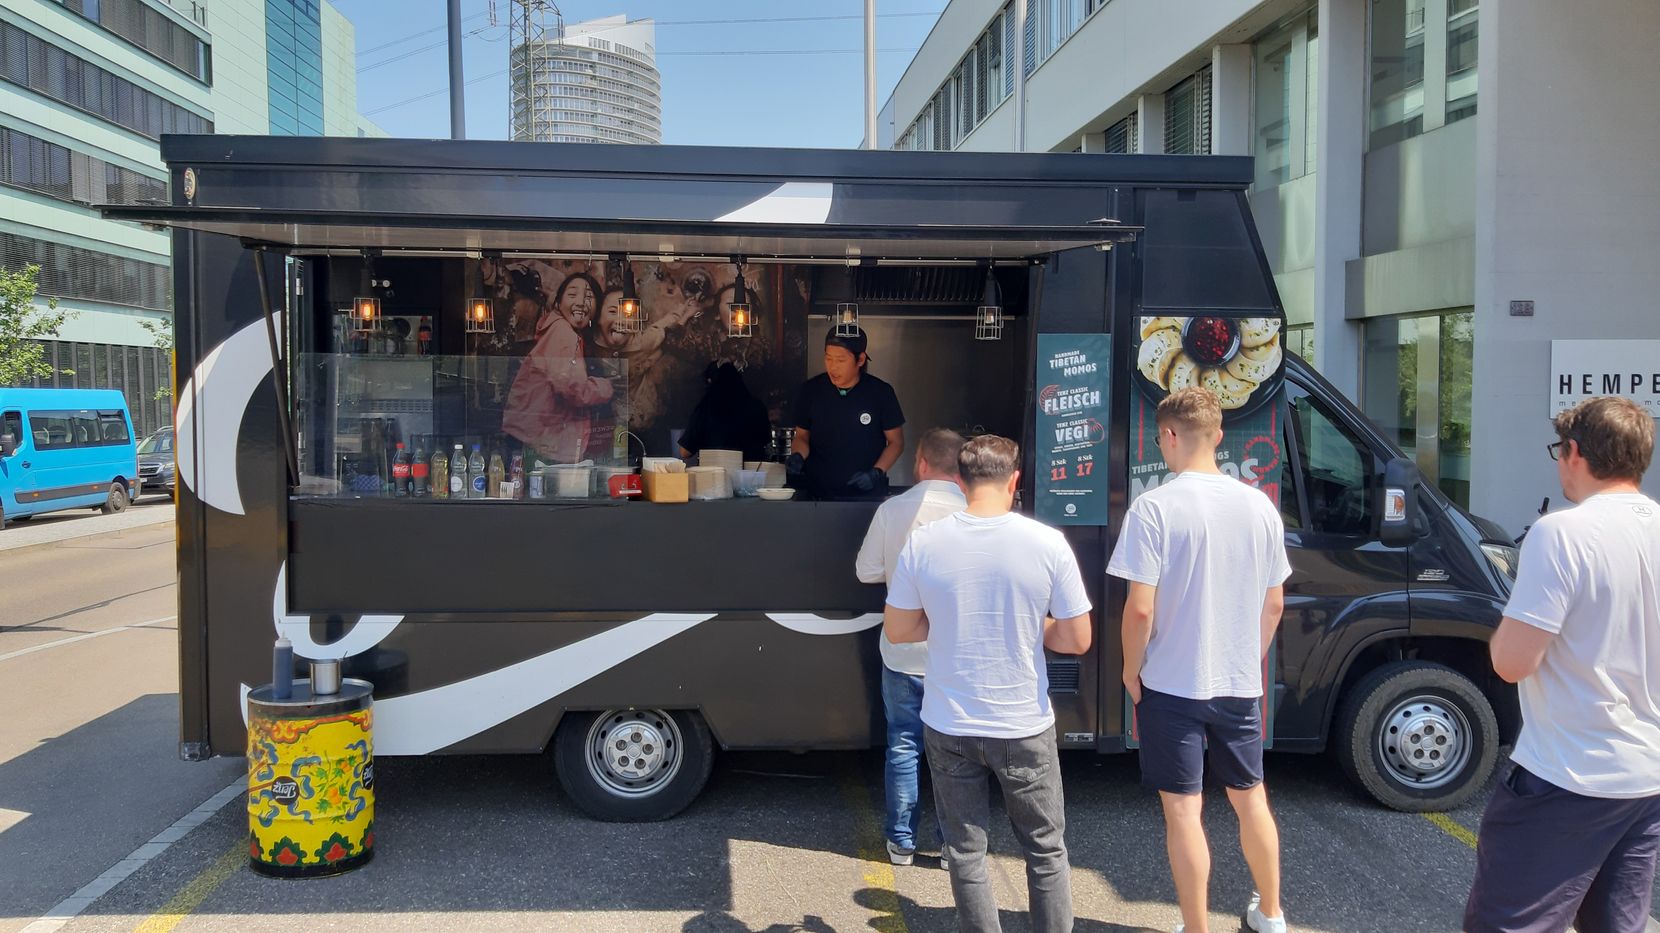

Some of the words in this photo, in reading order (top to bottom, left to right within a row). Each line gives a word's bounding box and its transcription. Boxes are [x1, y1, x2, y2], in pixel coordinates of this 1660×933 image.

[1049, 354, 1086, 368] TIBETAN
[1063, 363, 1097, 377] MOMOS
[1069, 386, 1088, 394] CLASSIC
[1559, 373, 1660, 395] HEMPE
[1044, 390, 1100, 413] FLEISCH
[1069, 418, 1088, 427] CLASSIC
[1055, 424, 1089, 442] VEGI
[1050, 467, 1067, 481] 11
[1076, 462, 1093, 477] 17
